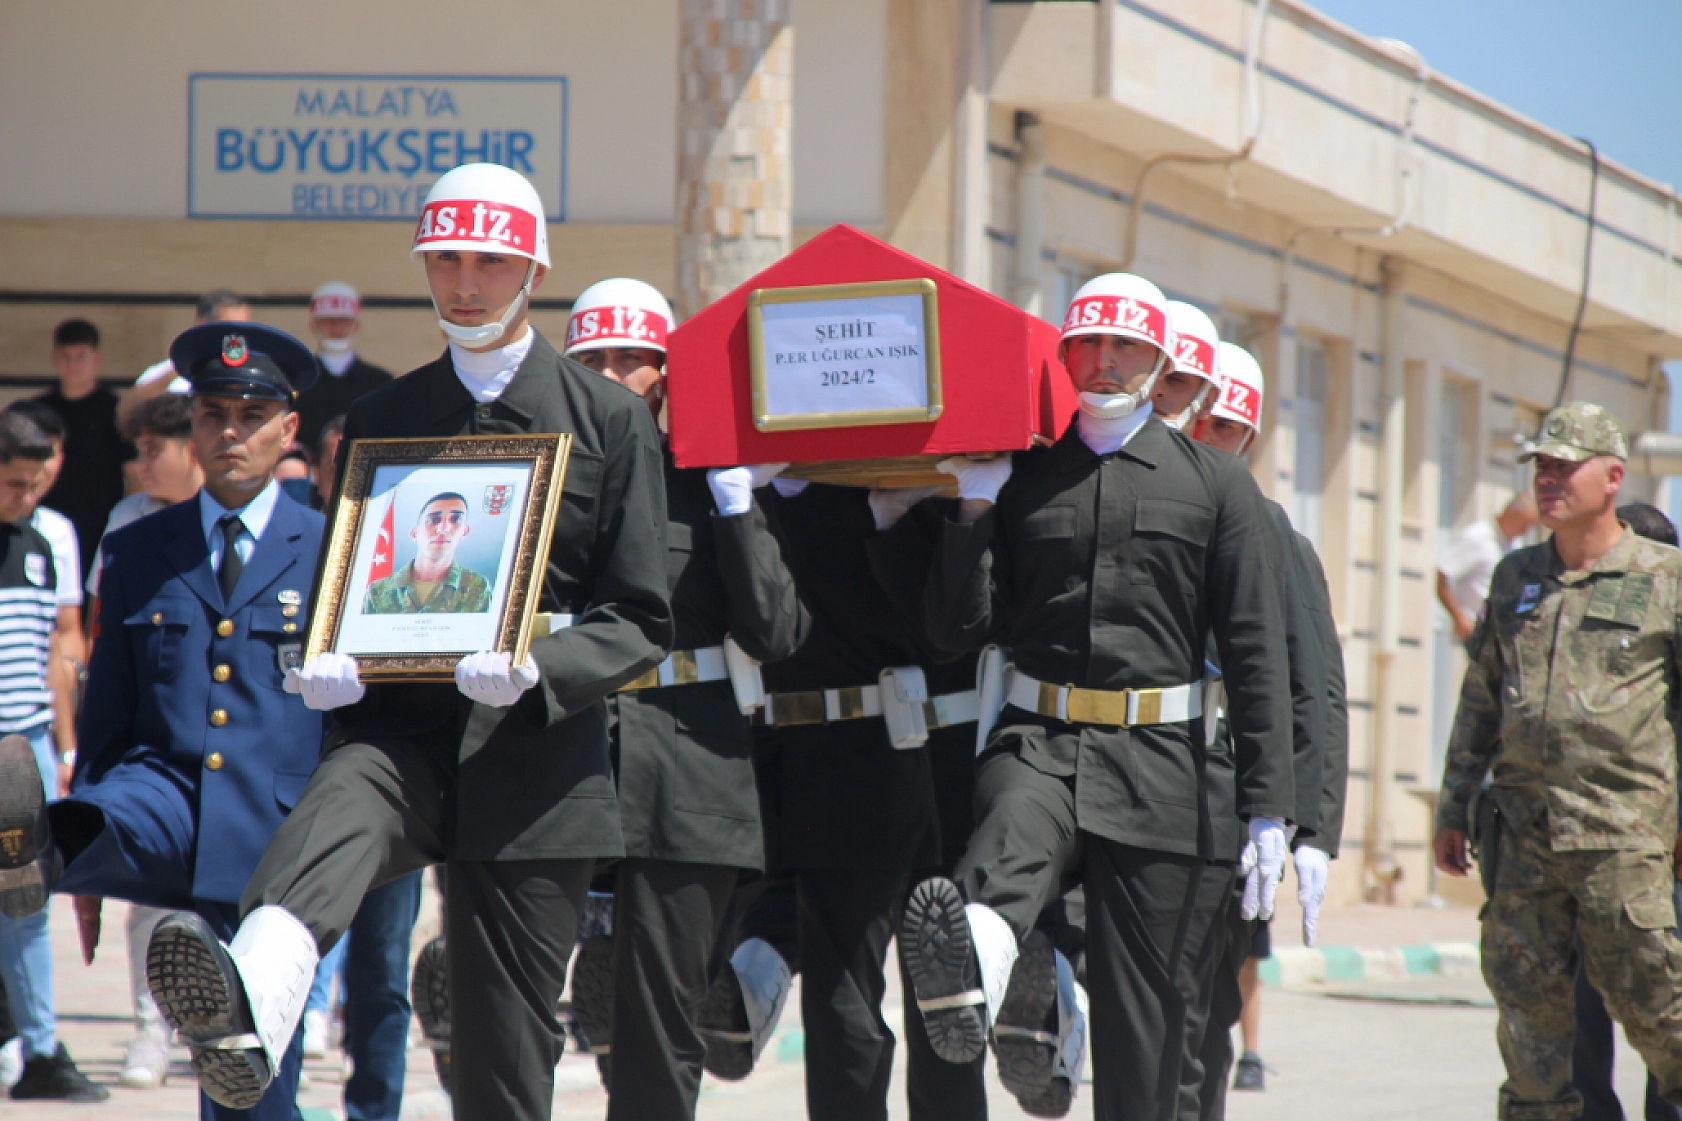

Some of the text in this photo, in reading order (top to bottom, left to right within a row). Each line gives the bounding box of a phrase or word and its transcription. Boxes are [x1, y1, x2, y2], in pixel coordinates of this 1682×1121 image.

[295, 86, 459, 116] MALATYA
[215, 129, 535, 178] BÜYÜKŞEHİR
[293, 184, 430, 214] BELEDİYE
[815, 318, 876, 343] ŞEHİT
[775, 345, 919, 364] P.ER UĞURCAN IŞIK
[821, 368, 875, 386] 2024/2
